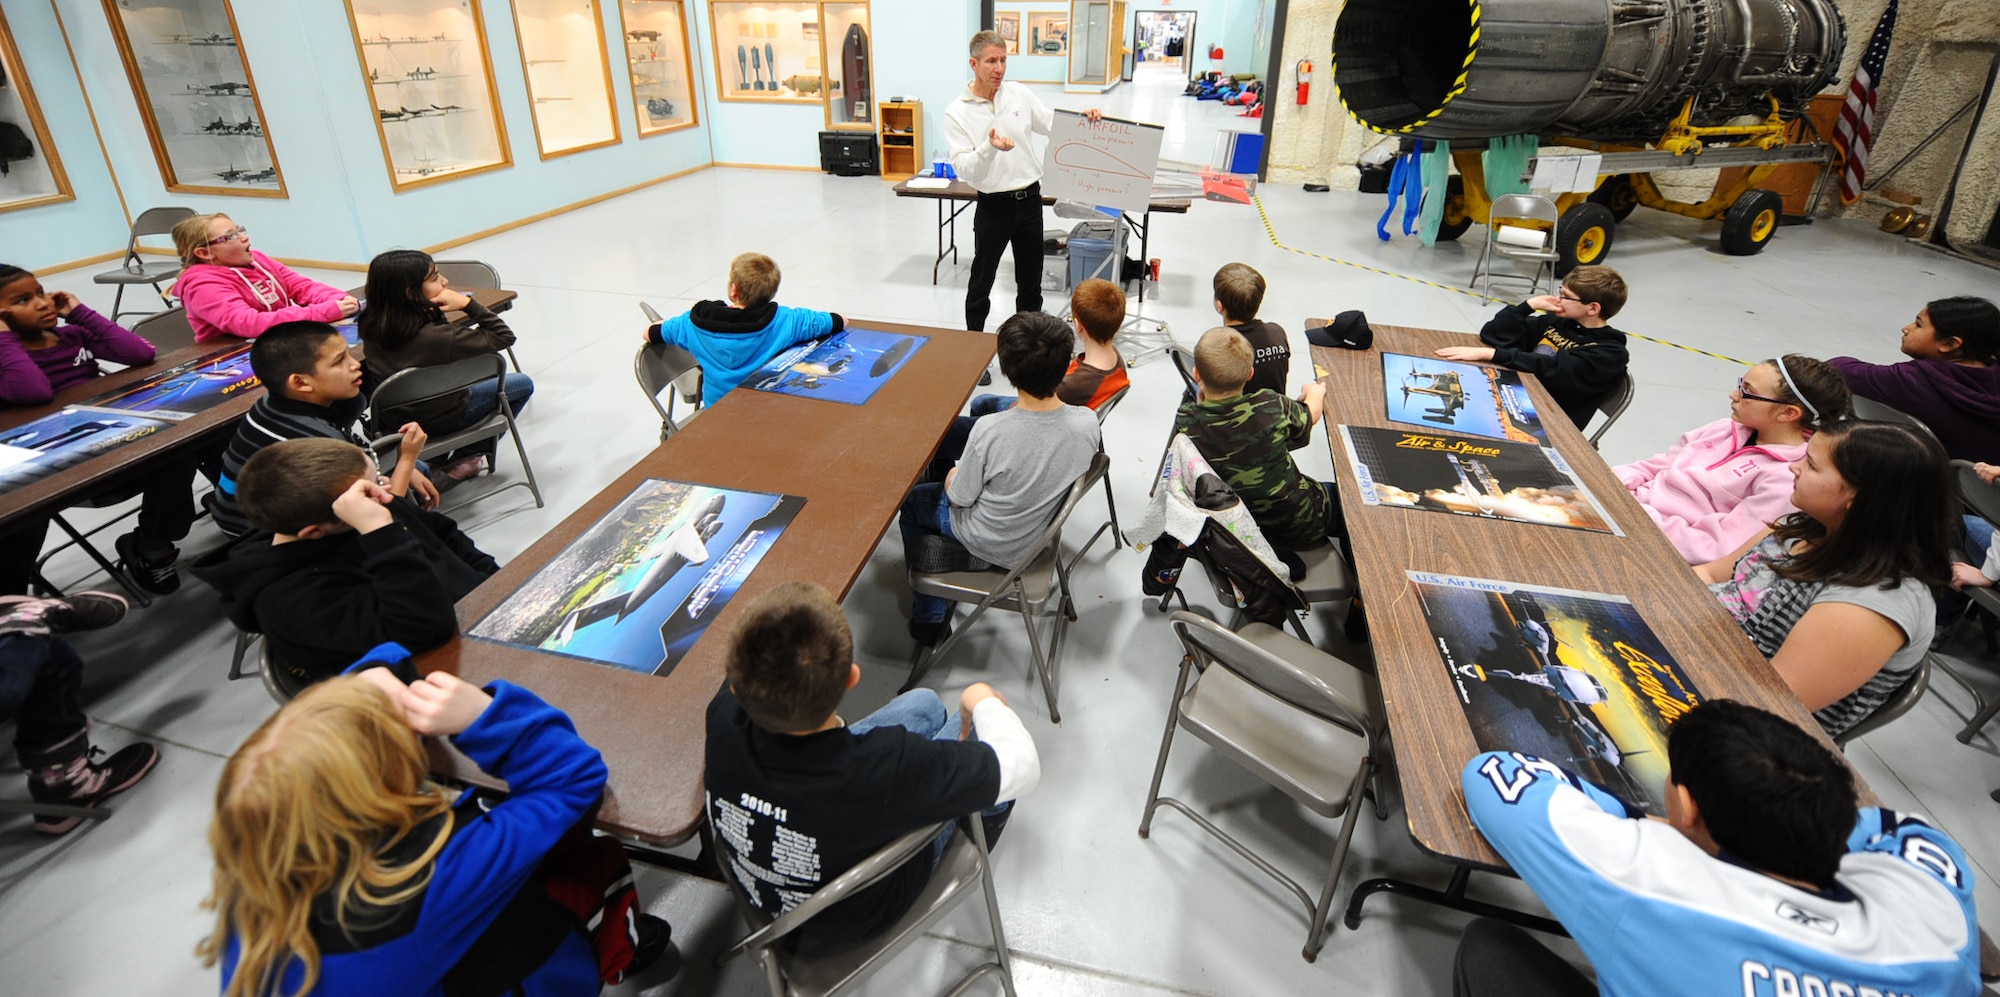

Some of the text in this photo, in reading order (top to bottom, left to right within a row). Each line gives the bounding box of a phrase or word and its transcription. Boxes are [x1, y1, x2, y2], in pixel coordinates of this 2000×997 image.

[1077, 118, 1132, 135] AIRFOIL
[1396, 435, 1431, 448] Air
[1433, 440, 1446, 449] &
[1448, 441, 1500, 454] Space
[687, 530, 765, 619] AIRPOWER
[1415, 573, 1508, 592] U.S. Air Force
[1612, 640, 1691, 725] Excelle
[740, 792, 788, 822] 2010-11
